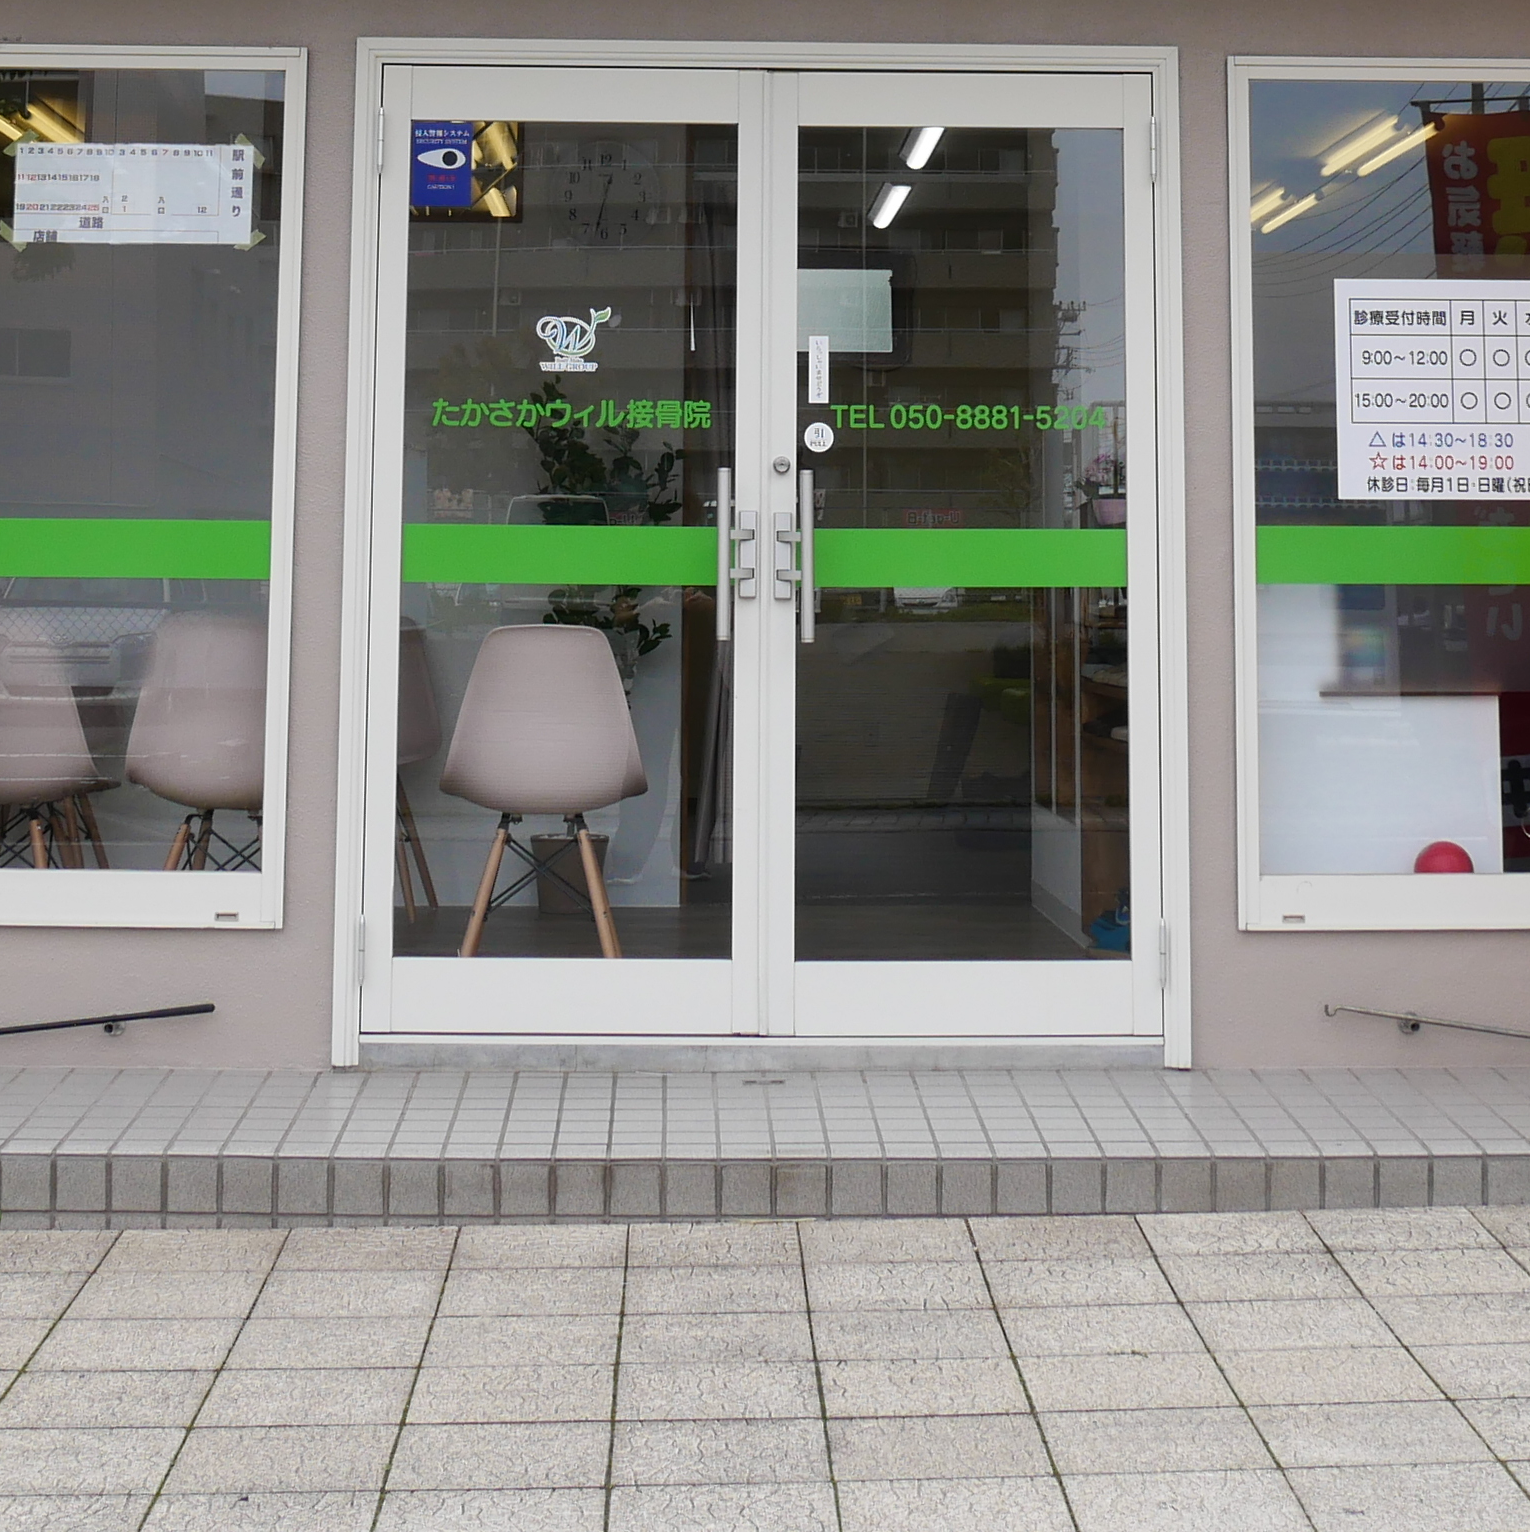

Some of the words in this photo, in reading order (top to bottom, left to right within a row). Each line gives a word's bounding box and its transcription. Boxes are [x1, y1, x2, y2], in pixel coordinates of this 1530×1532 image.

[1353, 310, 1447, 327] 診療受付時間
[1459, 310, 1476, 327] 月
[1492, 310, 1509, 327] 火
[431, 397, 712, 430] たかさかウィル接骨院
[830, 405, 886, 430] TEL
[889, 405, 1108, 431] 050-8881-5204
